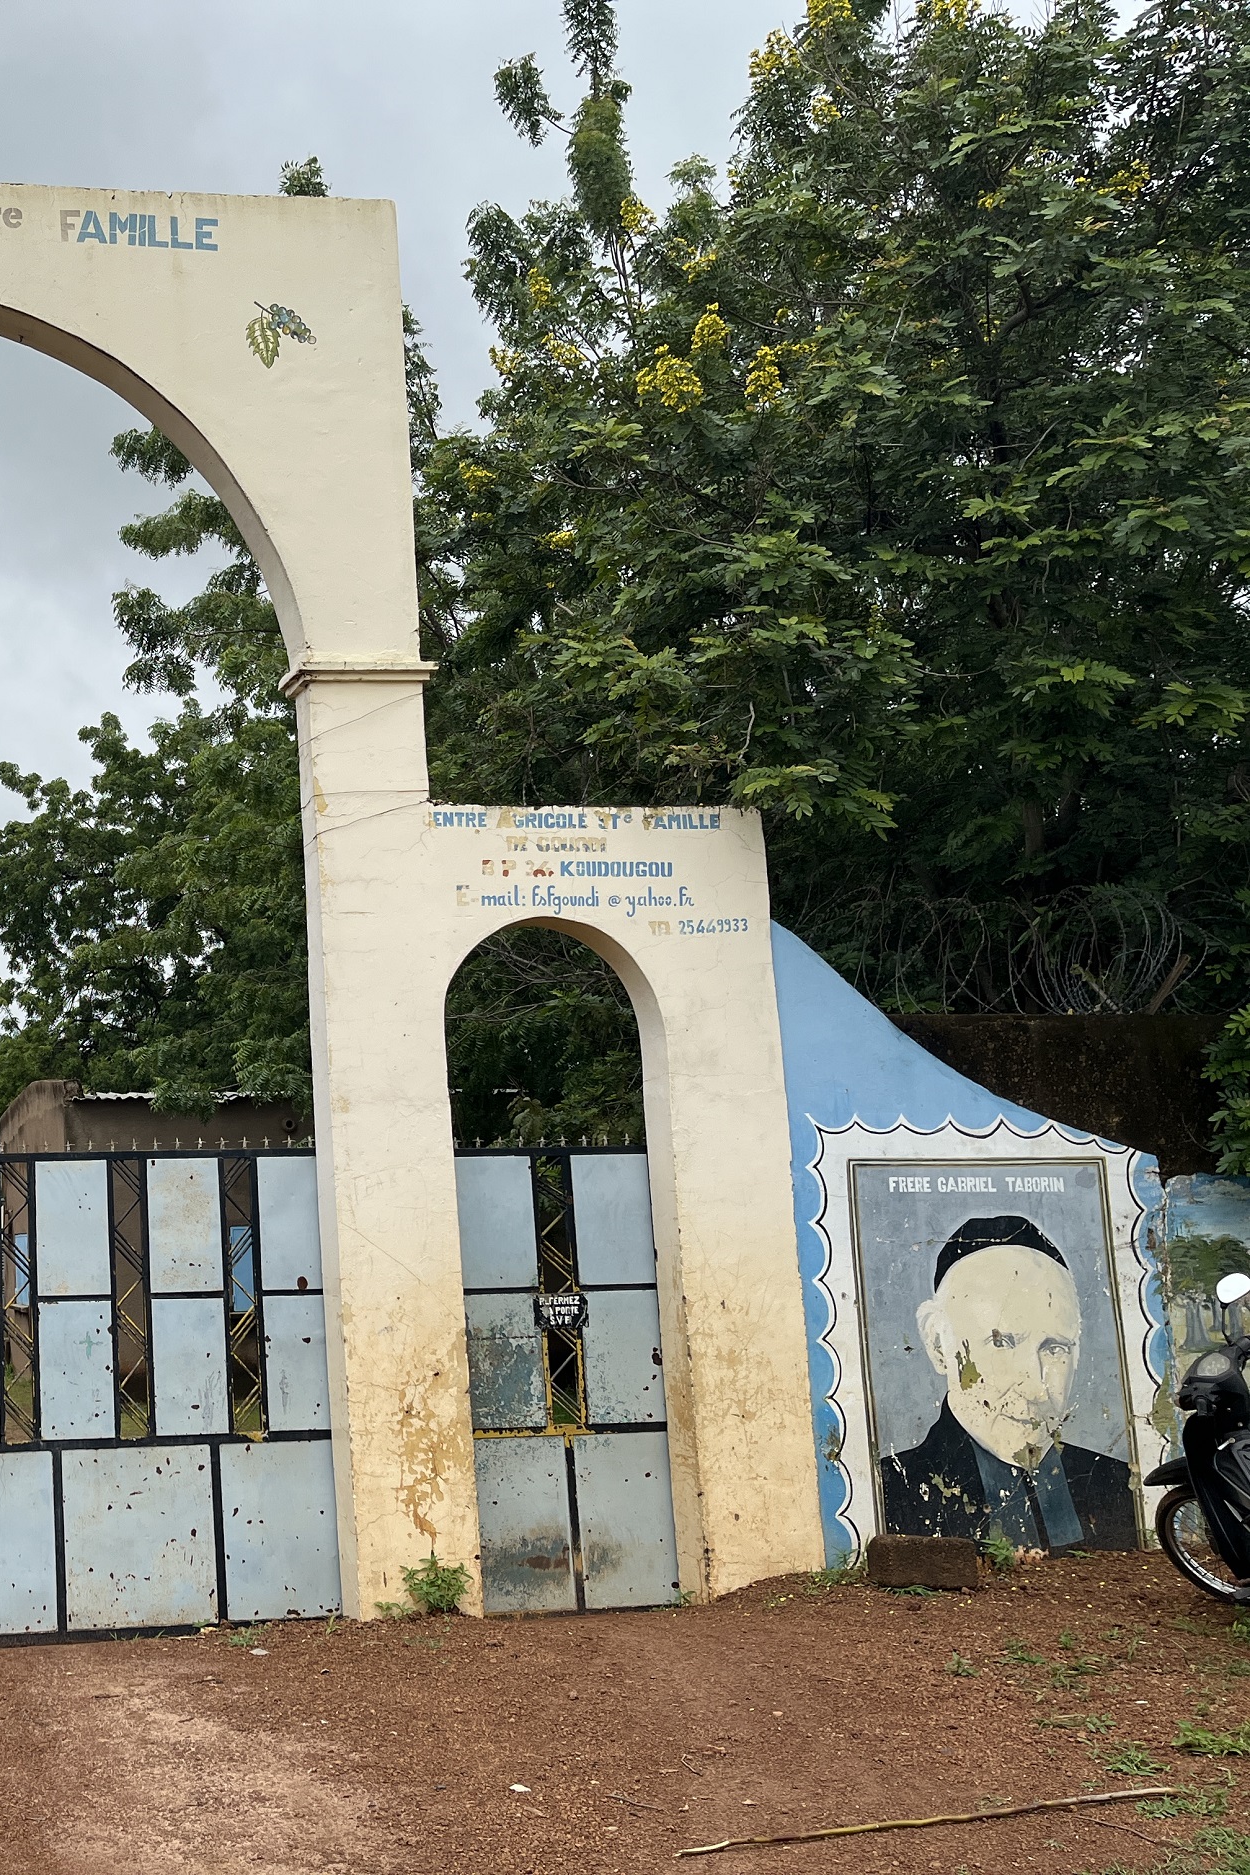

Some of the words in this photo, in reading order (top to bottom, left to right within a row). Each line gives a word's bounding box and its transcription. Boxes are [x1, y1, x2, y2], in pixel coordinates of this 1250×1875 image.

[59, 209, 219, 251] FAMILLE
[560, 860, 673, 877] KOUDOUGOU
[678, 918, 749, 935] 25449933
[888, 1176, 932, 1193] FRERE
[937, 1176, 997, 1193] GABRIEL
[1005, 1176, 1065, 1193] TABORIN
